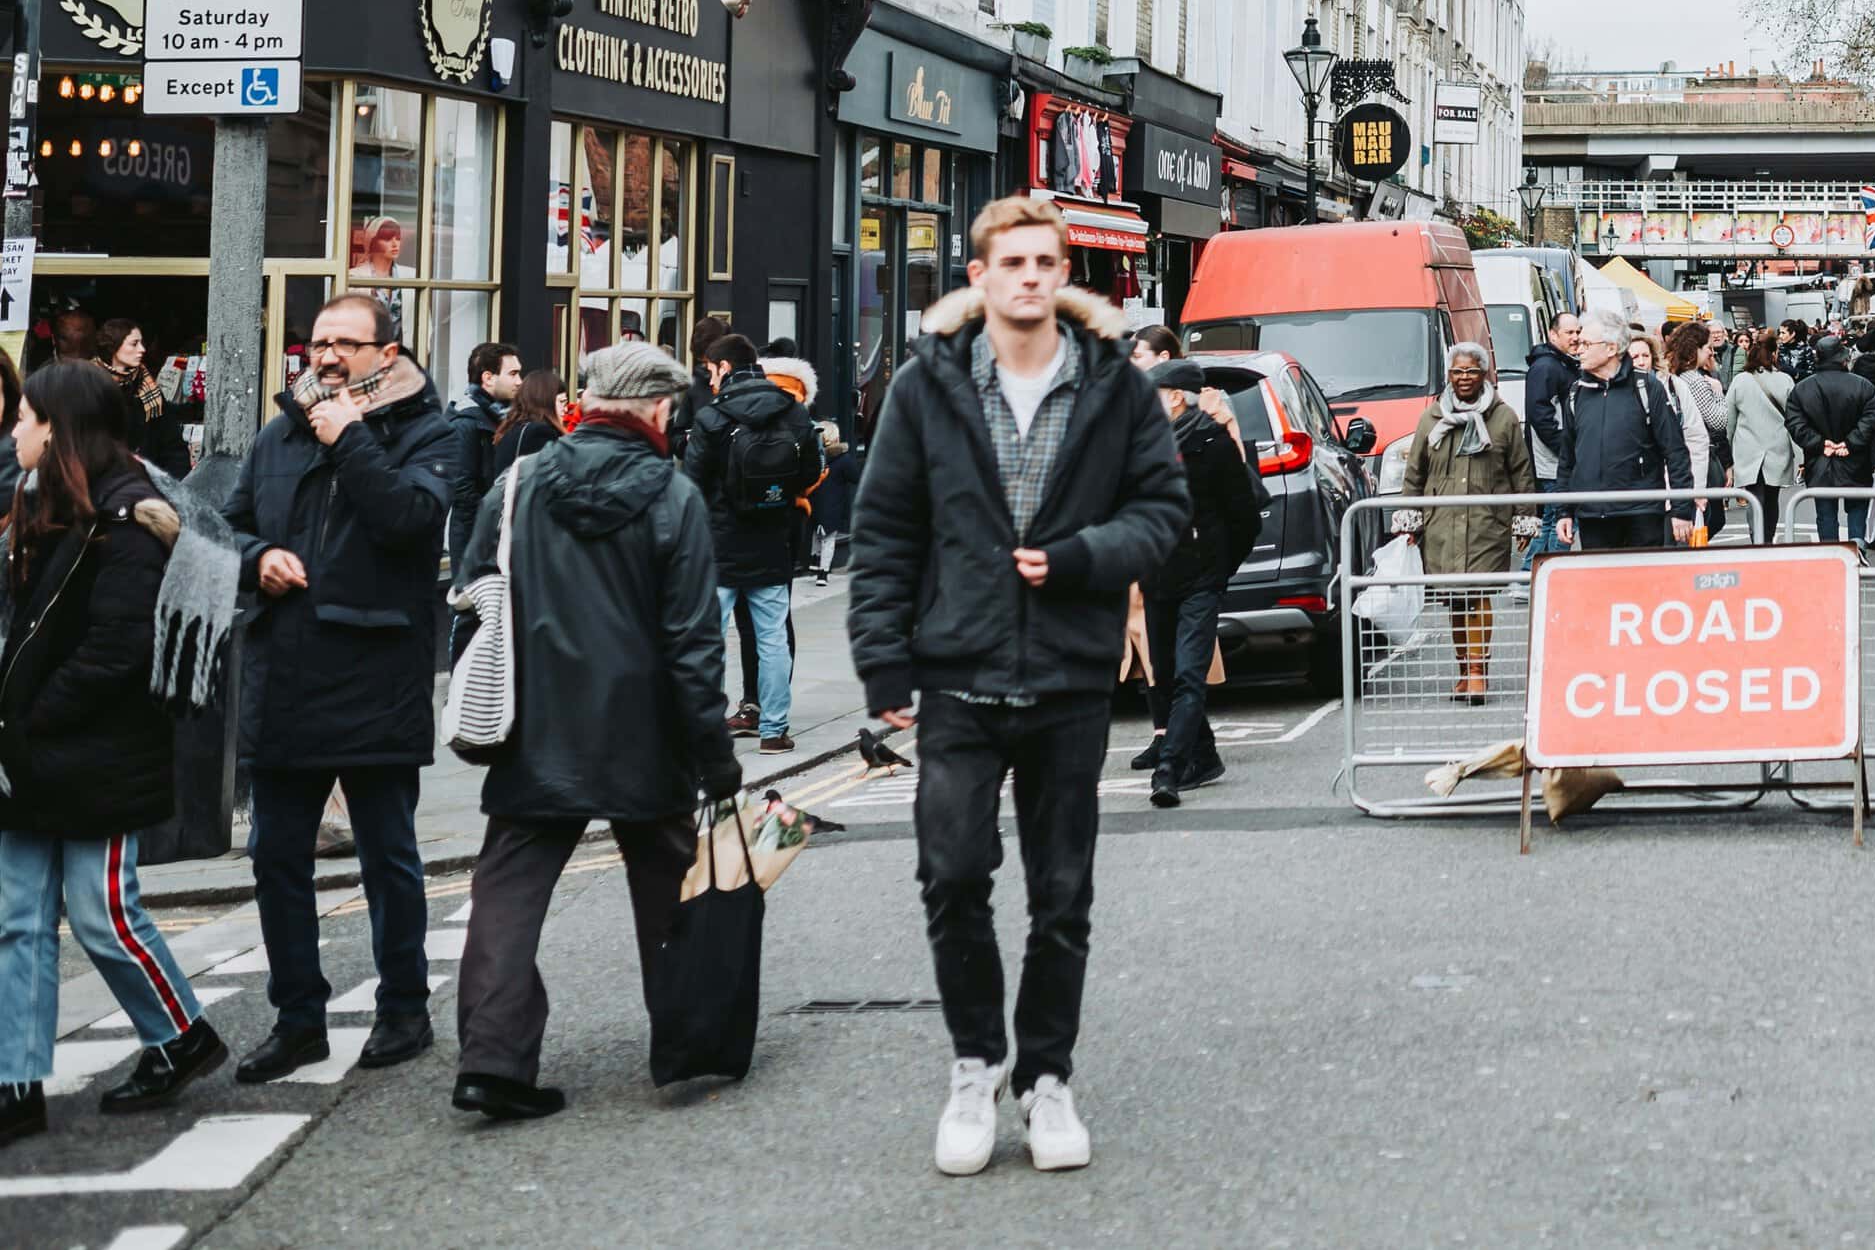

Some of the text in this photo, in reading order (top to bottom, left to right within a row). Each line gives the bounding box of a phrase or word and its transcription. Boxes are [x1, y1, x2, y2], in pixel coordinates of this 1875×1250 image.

[178, 9, 269, 28] Saturday
[162, 34, 185, 49] 10
[190, 37, 218, 49] am
[235, 33, 249, 49] 4
[254, 36, 283, 51] pm
[558, 23, 726, 104] CLOTHING & ACCESSORIES
[167, 79, 234, 97] Except
[1438, 108, 1477, 119] FOR SALE
[1352, 121, 1392, 136] MAU
[1352, 135, 1392, 150] MAU
[1354, 150, 1392, 165] BAR
[1609, 598, 1783, 646] ROAD
[1565, 667, 1822, 718] CLOSED
